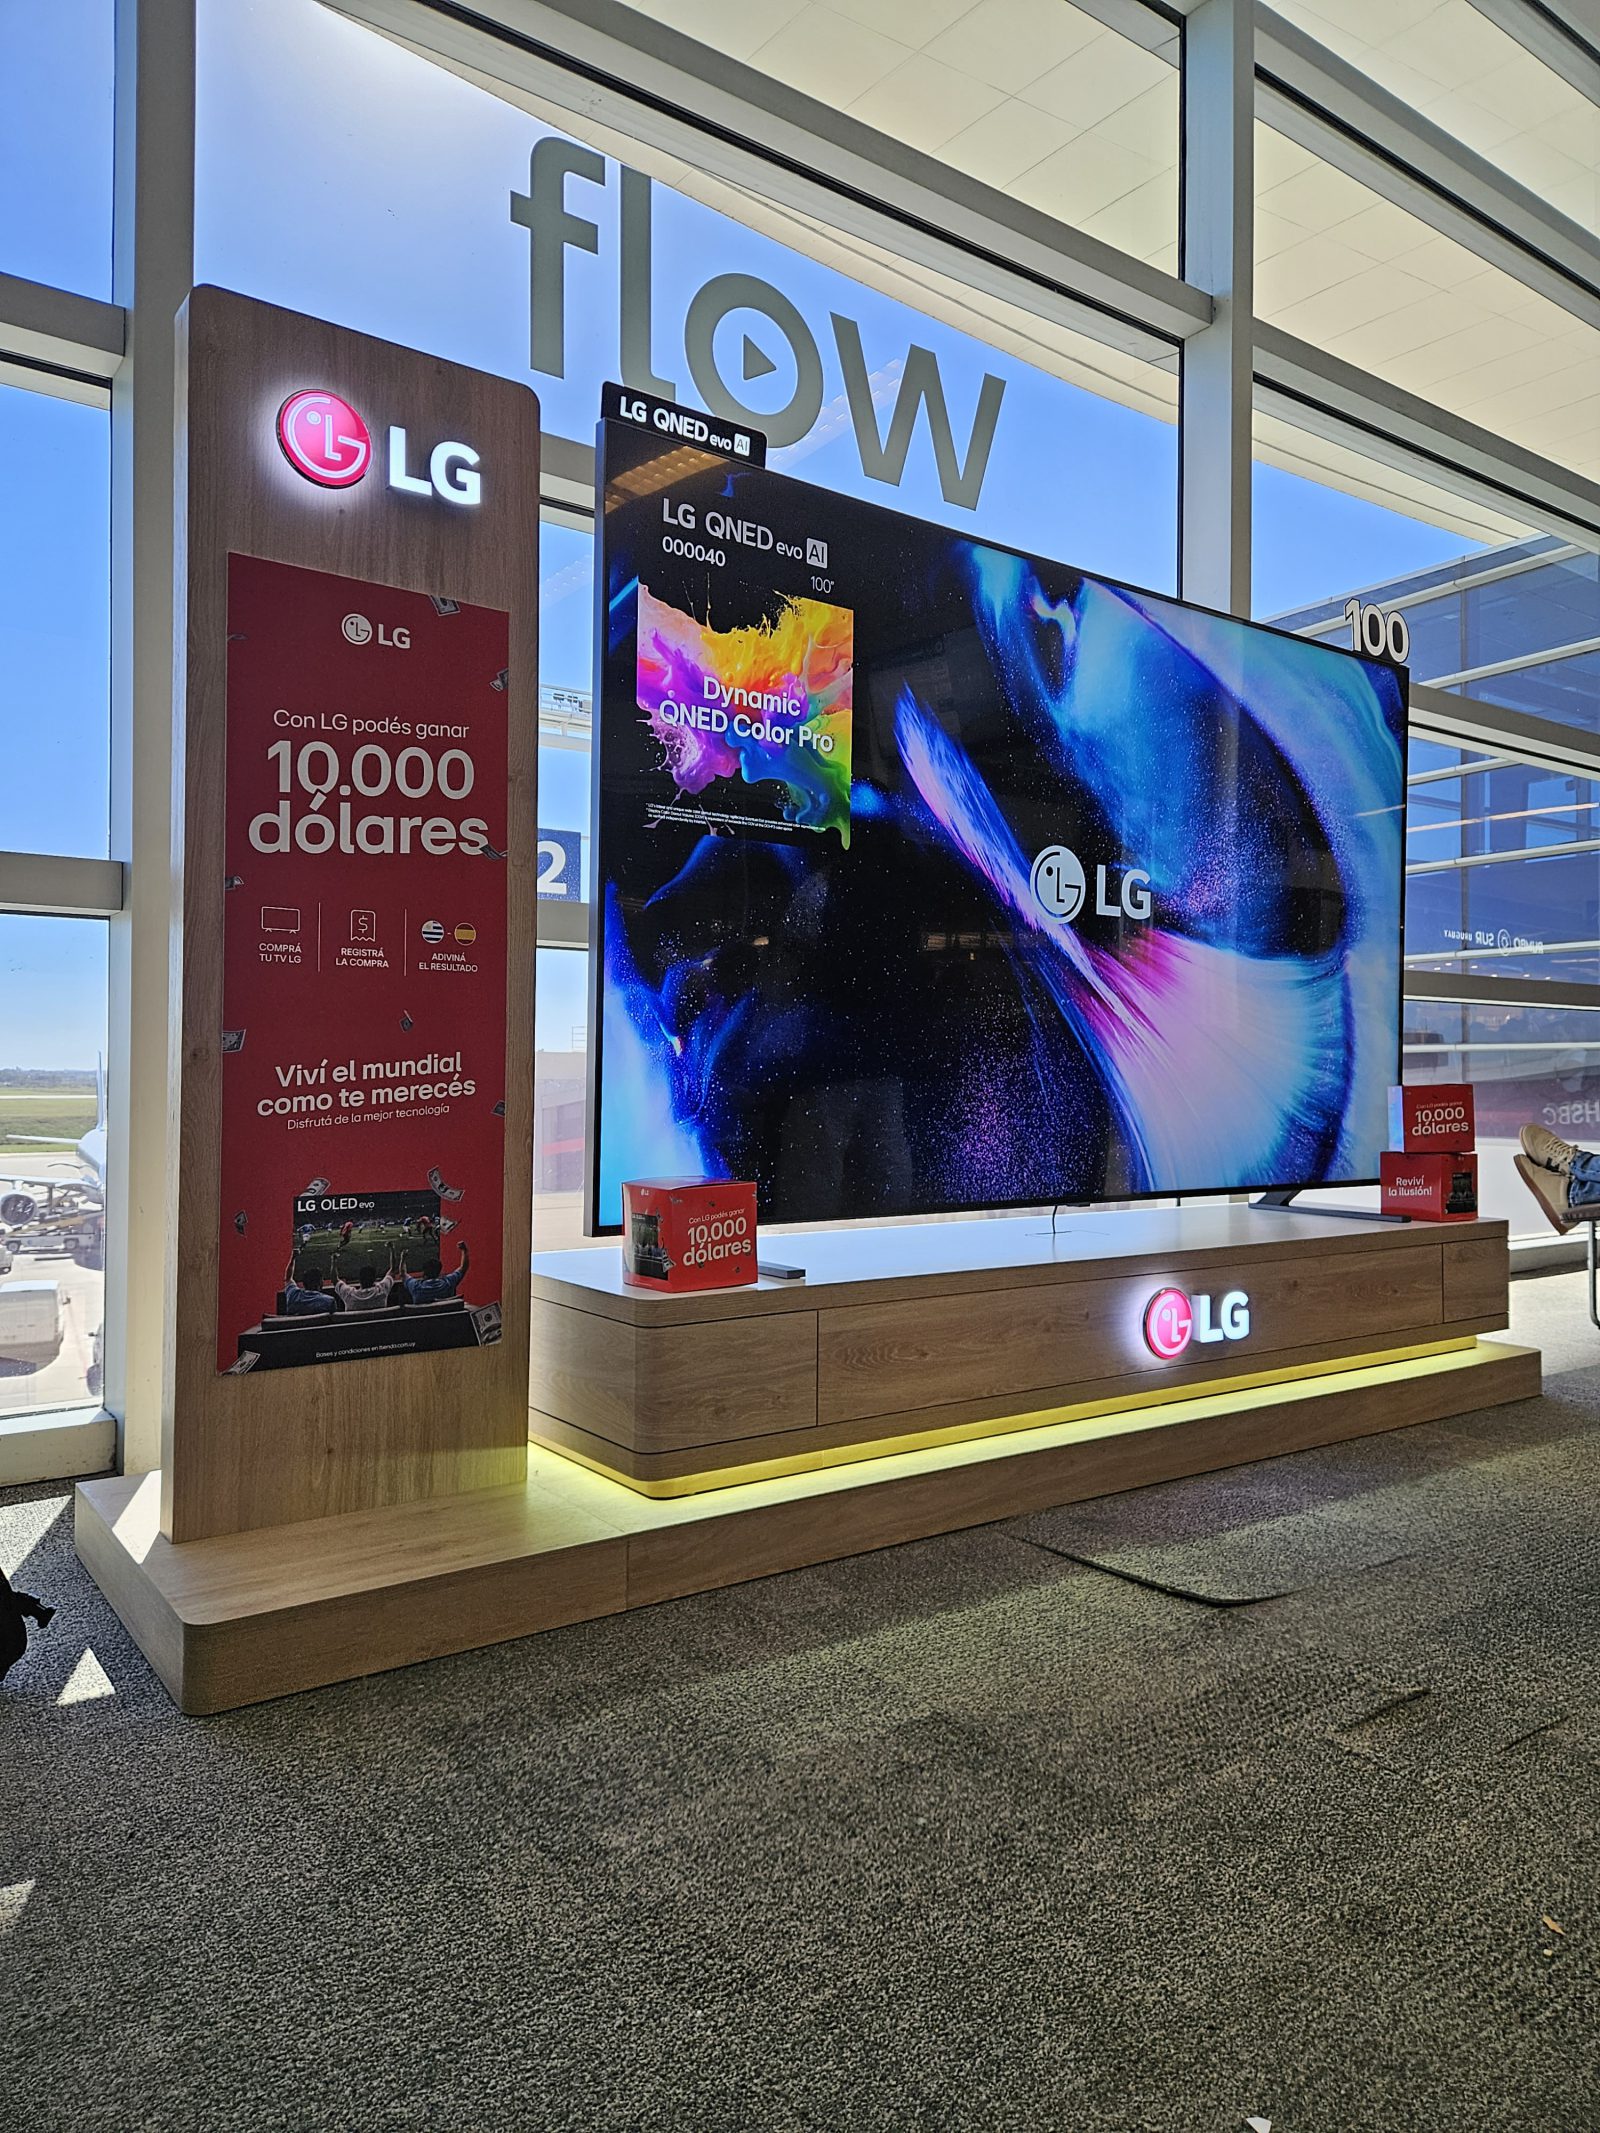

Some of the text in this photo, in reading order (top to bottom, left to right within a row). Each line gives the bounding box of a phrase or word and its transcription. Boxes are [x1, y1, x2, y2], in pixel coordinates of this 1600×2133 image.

[619, 396, 749, 454] LG QNED evo AI
[388, 424, 481, 505] LG
[663, 497, 826, 566] LG QNED evo AI
[662, 535, 726, 567] 000040
[377, 623, 411, 650] LG
[1344, 597, 1410, 664] 100
[703, 676, 801, 717] Dynamic
[273, 709, 470, 739] Con LG podés ganar
[659, 700, 834, 753] QNED Color Pro
[267, 740, 475, 800] 10.000
[248, 791, 489, 856] dólares
[1096, 864, 1152, 920] LG
[258, 942, 302, 954] COMPRÁ
[259, 953, 302, 964] TU TV LG
[340, 947, 385, 958] REGISTRÁ
[431, 952, 466, 962] ADIVINÁ
[335, 957, 390, 969] LA COMPRA
[418, 962, 478, 973] EL RESULTADO
[275, 1052, 463, 1087] Viví el mundial
[257, 1073, 477, 1117] como te merecés
[287, 1103, 450, 1130] Disfrutá de la mejor tecnología
[1411, 1121, 1469, 1136] dólares
[1415, 1107, 1465, 1123] 10.000
[1388, 1185, 1433, 1197] la ilusión!
[1396, 1174, 1425, 1186] Reviví
[297, 1198, 375, 1212] LG OLED evo
[688, 1217, 702, 1225] Con
[702, 1214, 710, 1222] LG
[710, 1211, 729, 1221] podés
[687, 1216, 747, 1246] 10.000
[682, 1238, 752, 1266] dólares
[1194, 1291, 1250, 1343] LG
